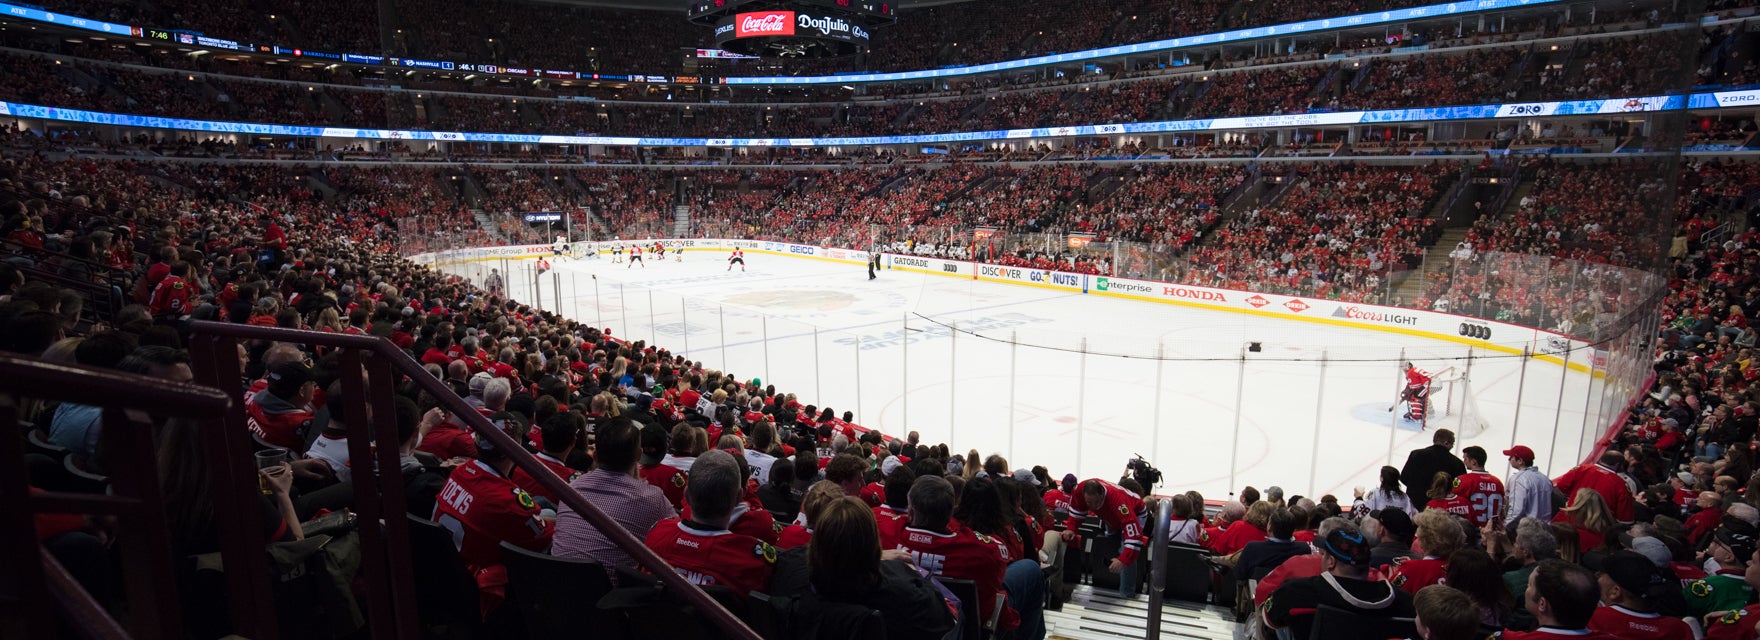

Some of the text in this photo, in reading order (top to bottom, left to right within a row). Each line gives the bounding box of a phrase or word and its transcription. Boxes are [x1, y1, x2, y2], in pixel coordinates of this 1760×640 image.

[11, 7, 27, 16] AT&T
[1409, 9, 1426, 17] AT&T
[72, 18, 86, 26] AT&T
[742, 14, 786, 33] Coca-Cola
[1347, 16, 1363, 24] AT&T
[150, 30, 168, 39] 7:46
[1509, 104, 1542, 115] ZORO
[789, 245, 814, 255] GEICO
[893, 257, 928, 268] GATORADE
[981, 266, 1021, 279] DISCOVER
[1053, 273, 1078, 286] NUTS!
[1163, 287, 1227, 302] HONDA
[1247, 297, 1267, 305] ORKIN
[1285, 301, 1306, 309] ORKIN
[1345, 306, 1418, 326] Coors LIGHT
[1479, 482, 1497, 492] SAAD
[440, 478, 474, 515] TOEWS
[1125, 523, 1140, 537] 81
[676, 538, 700, 549] Reebok
[1628, 622, 1659, 633] Reebok
